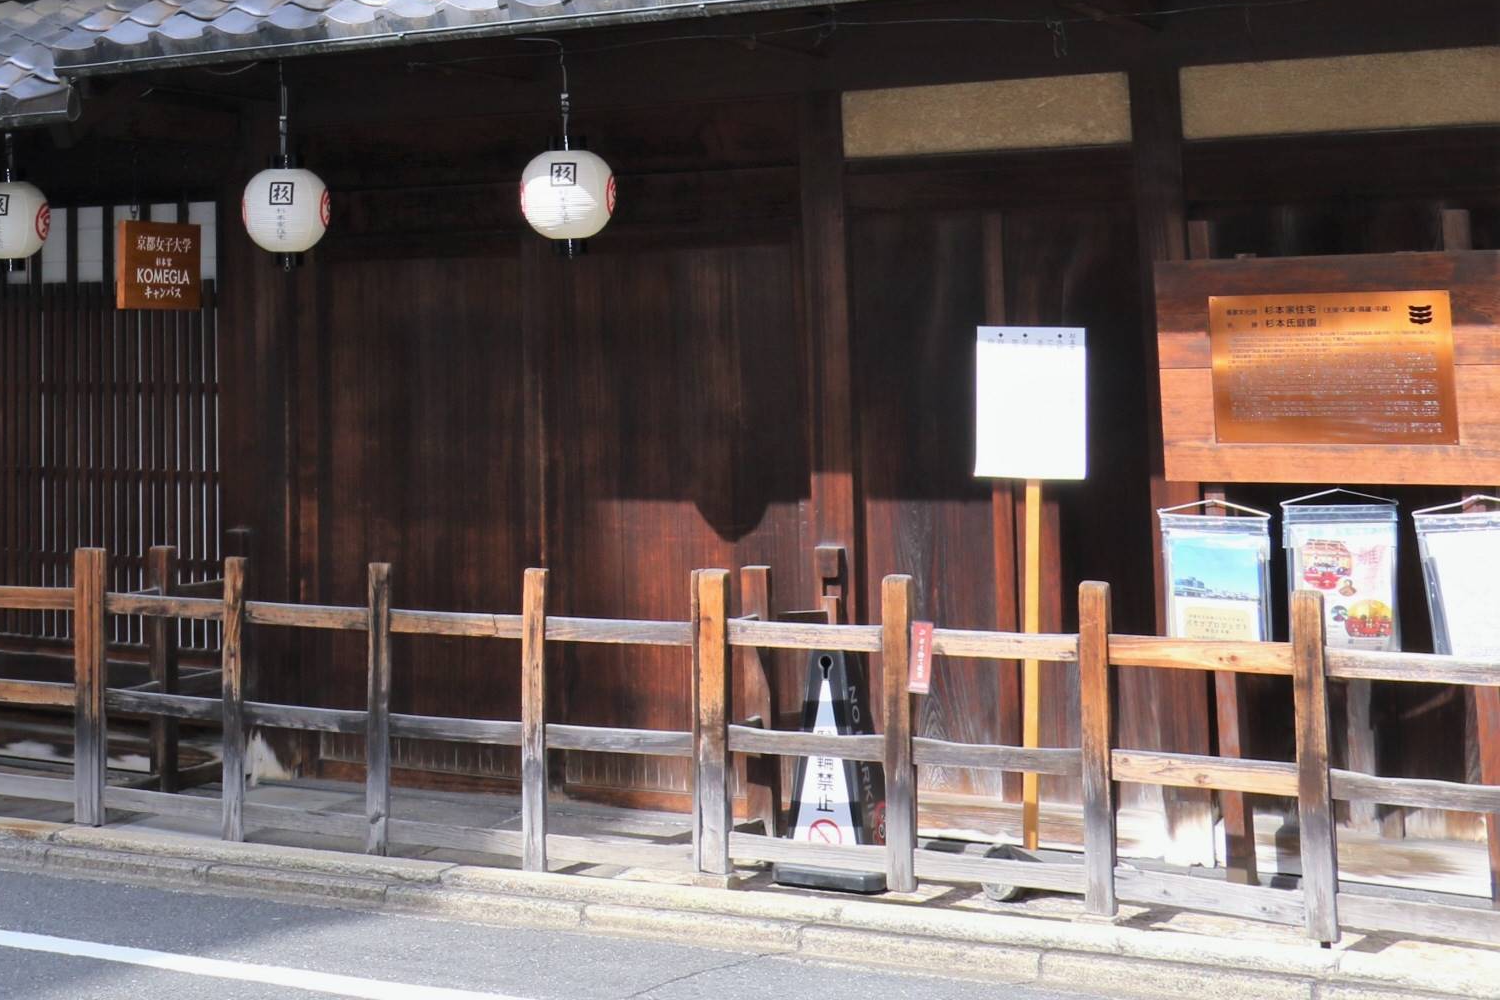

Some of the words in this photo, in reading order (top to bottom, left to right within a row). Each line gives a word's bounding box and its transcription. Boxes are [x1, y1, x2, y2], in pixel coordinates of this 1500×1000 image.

[137, 235, 192, 253] 京都女子大学
[136, 268, 190, 285] KOMEGLA
[145, 285, 182, 299] キャンパス
[848, 685, 861, 725] NO
[817, 730, 835, 812] 輪禁止
